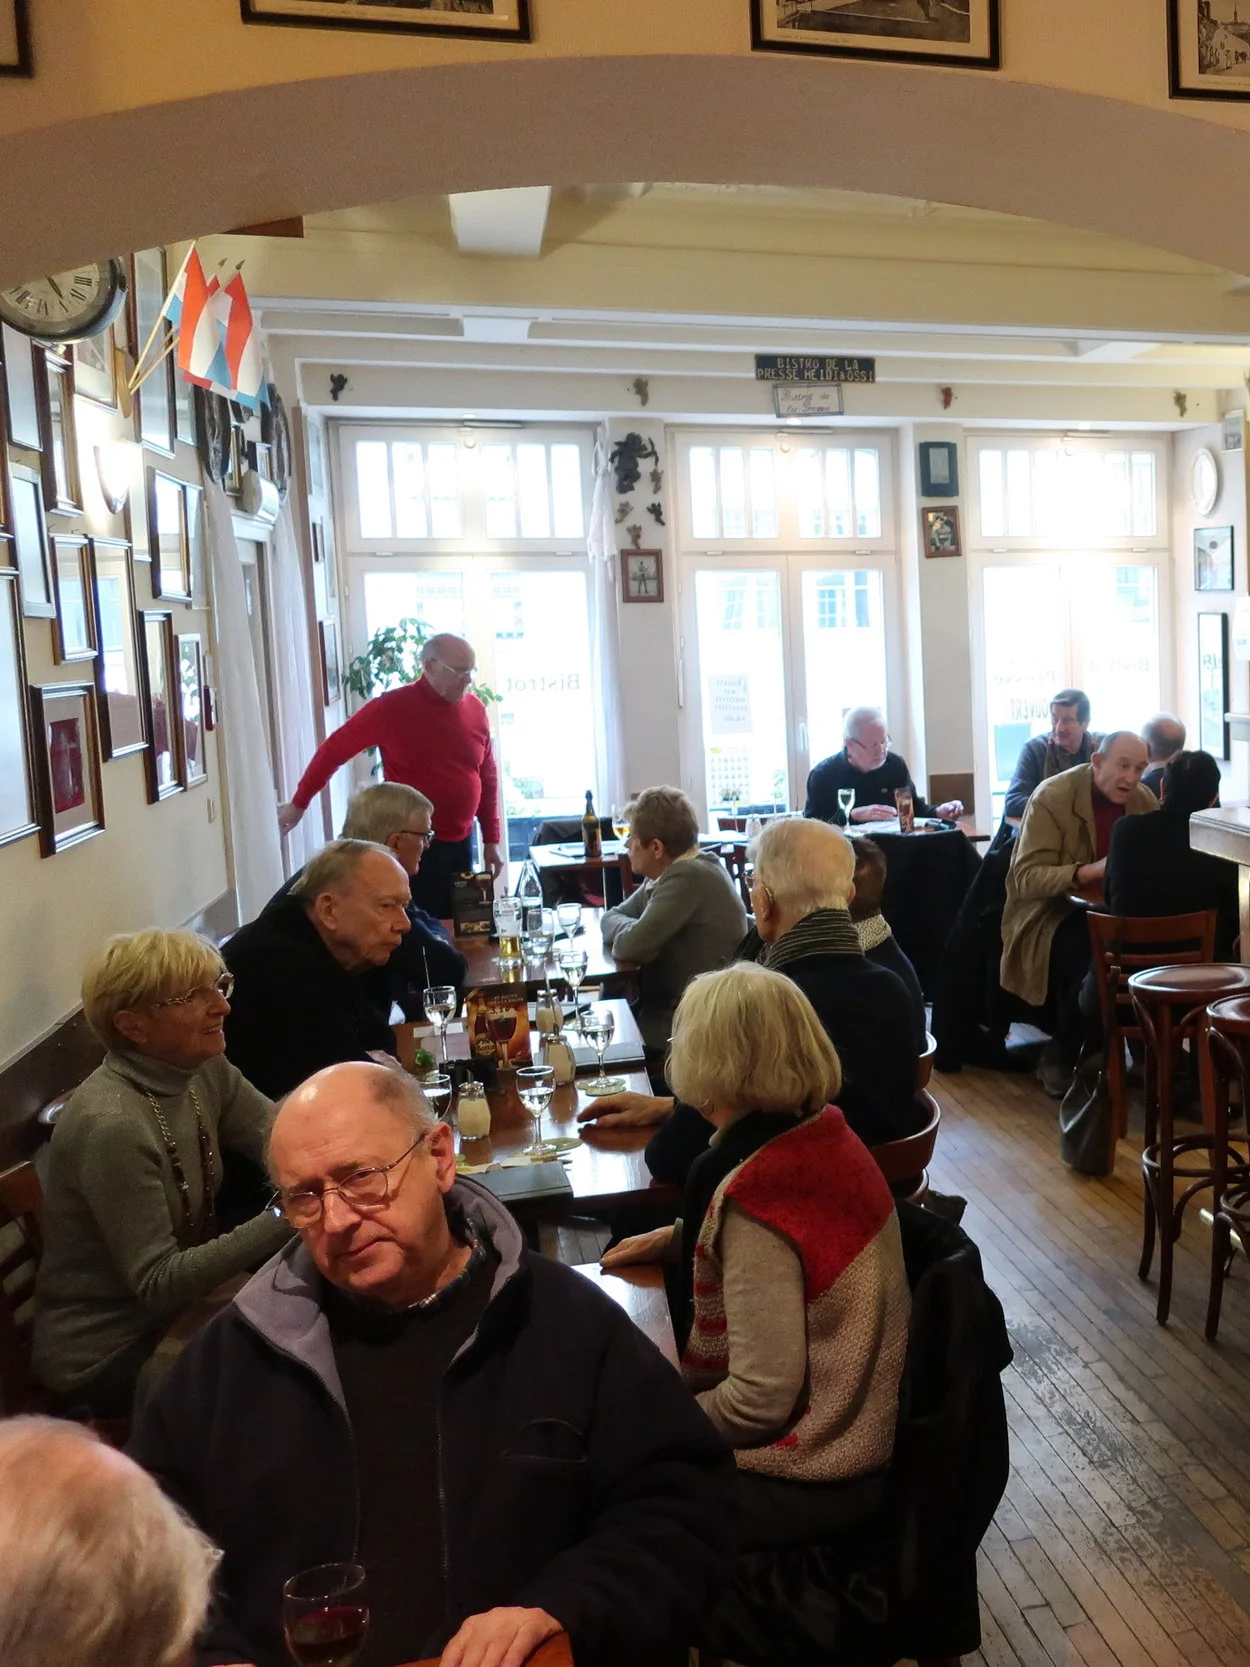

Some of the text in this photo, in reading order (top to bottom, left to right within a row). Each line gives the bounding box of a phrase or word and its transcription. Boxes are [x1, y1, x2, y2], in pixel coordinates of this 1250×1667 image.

[777, 357, 859, 370] BISTRO DE LA
[757, 368, 800, 380] PRESSE
